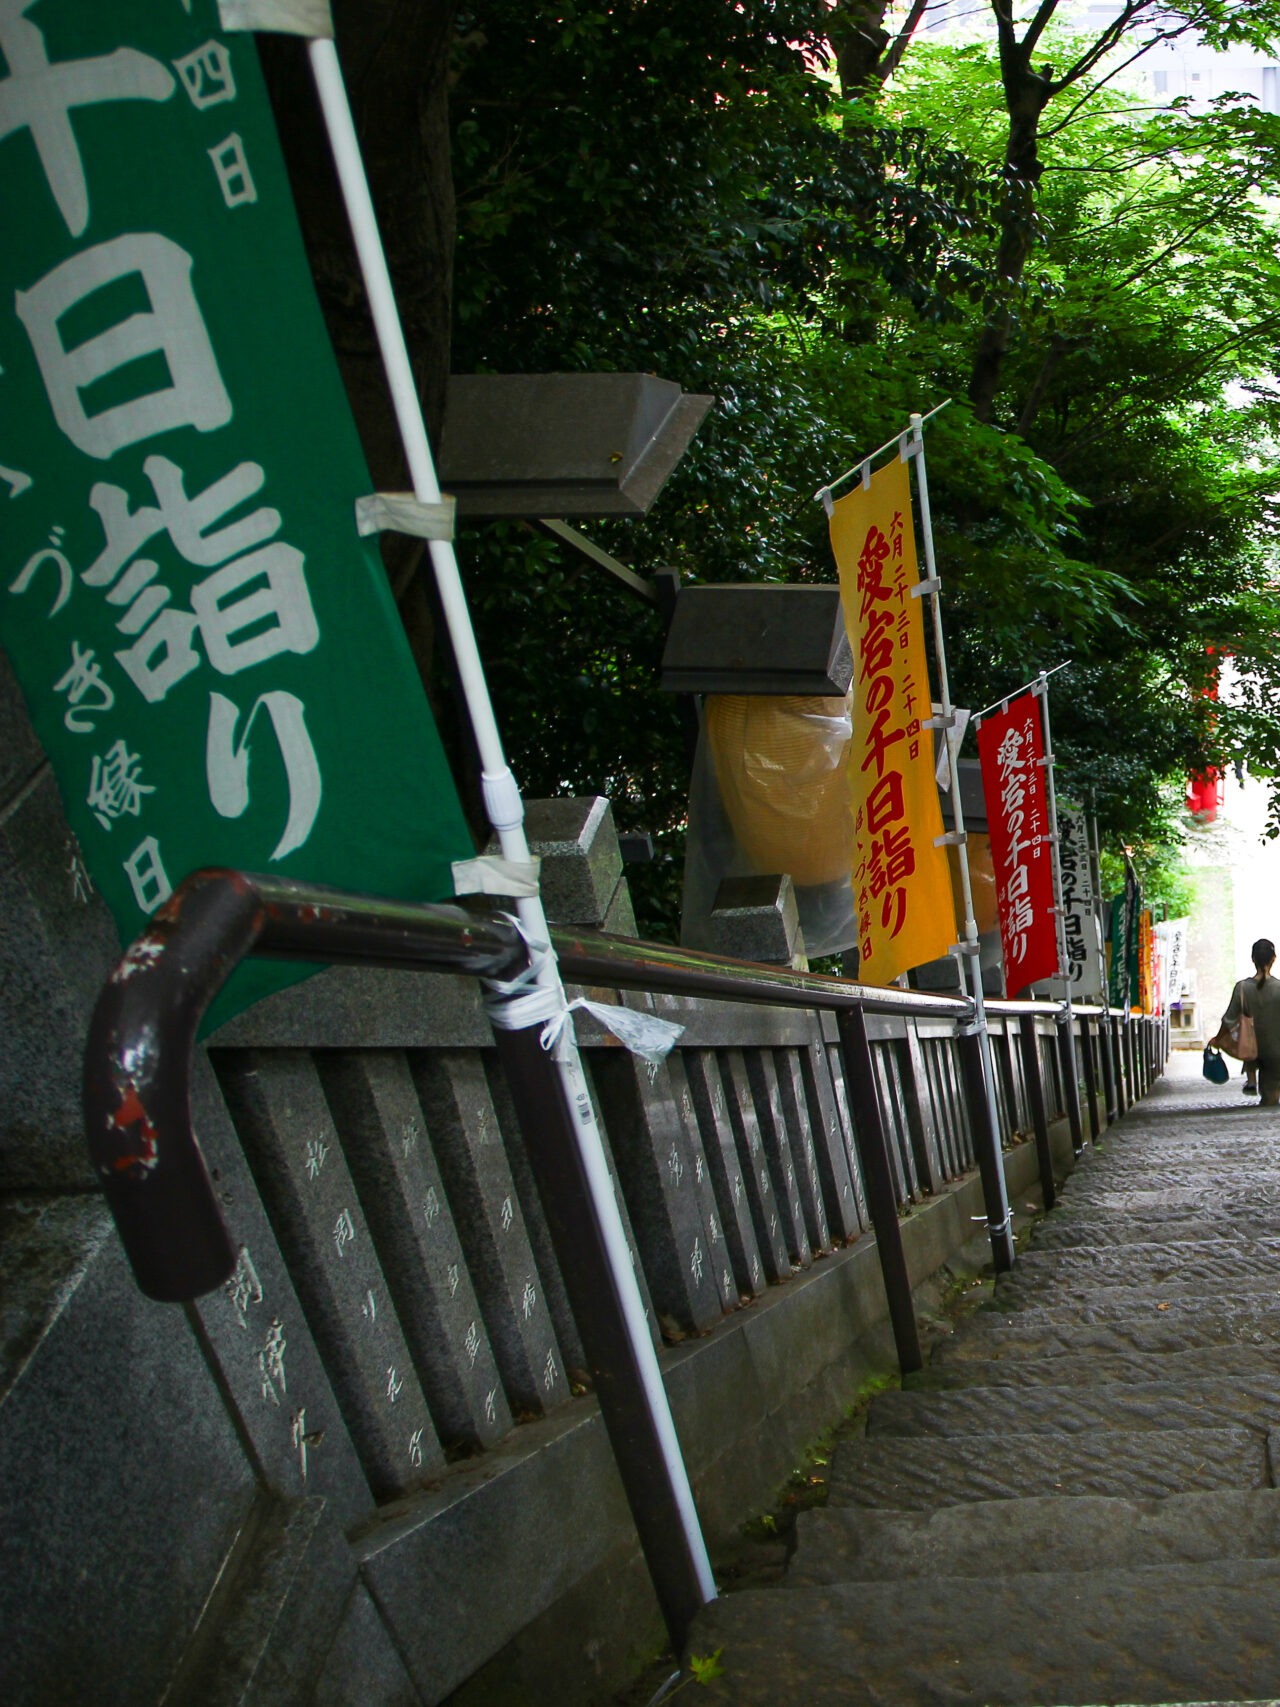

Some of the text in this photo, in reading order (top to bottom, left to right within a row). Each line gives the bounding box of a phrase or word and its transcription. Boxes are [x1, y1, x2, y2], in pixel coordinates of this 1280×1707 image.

[172, 0, 258, 209] 四日
[857, 525, 915, 940] 愛宕の千日詣り
[997, 728, 1033, 964] 愛宕の千日詣り
